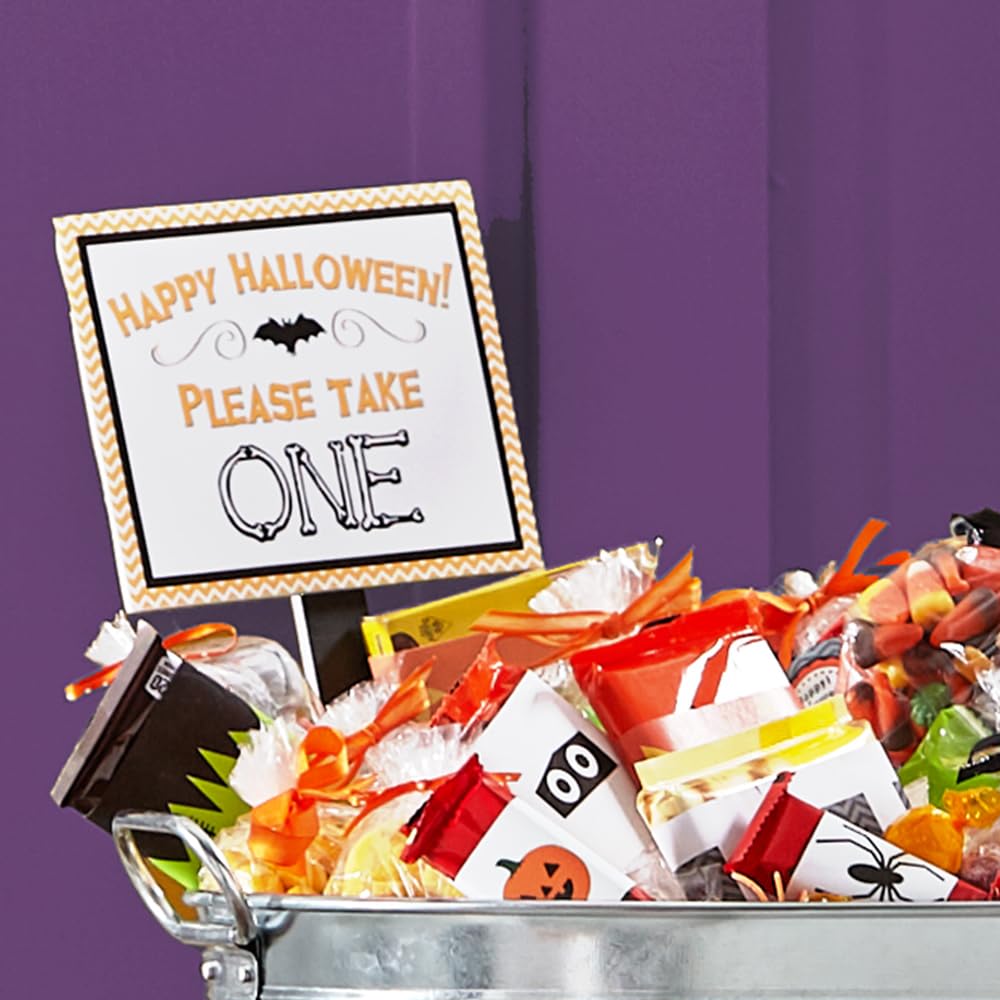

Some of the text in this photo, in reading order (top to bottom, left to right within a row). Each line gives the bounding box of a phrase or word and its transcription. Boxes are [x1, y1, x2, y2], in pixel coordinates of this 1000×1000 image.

[107, 252, 452, 337] HAPPY HALLOWEEN!
[177, 369, 424, 428] PLEASE TAKE
[218, 429, 424, 542] ONE
